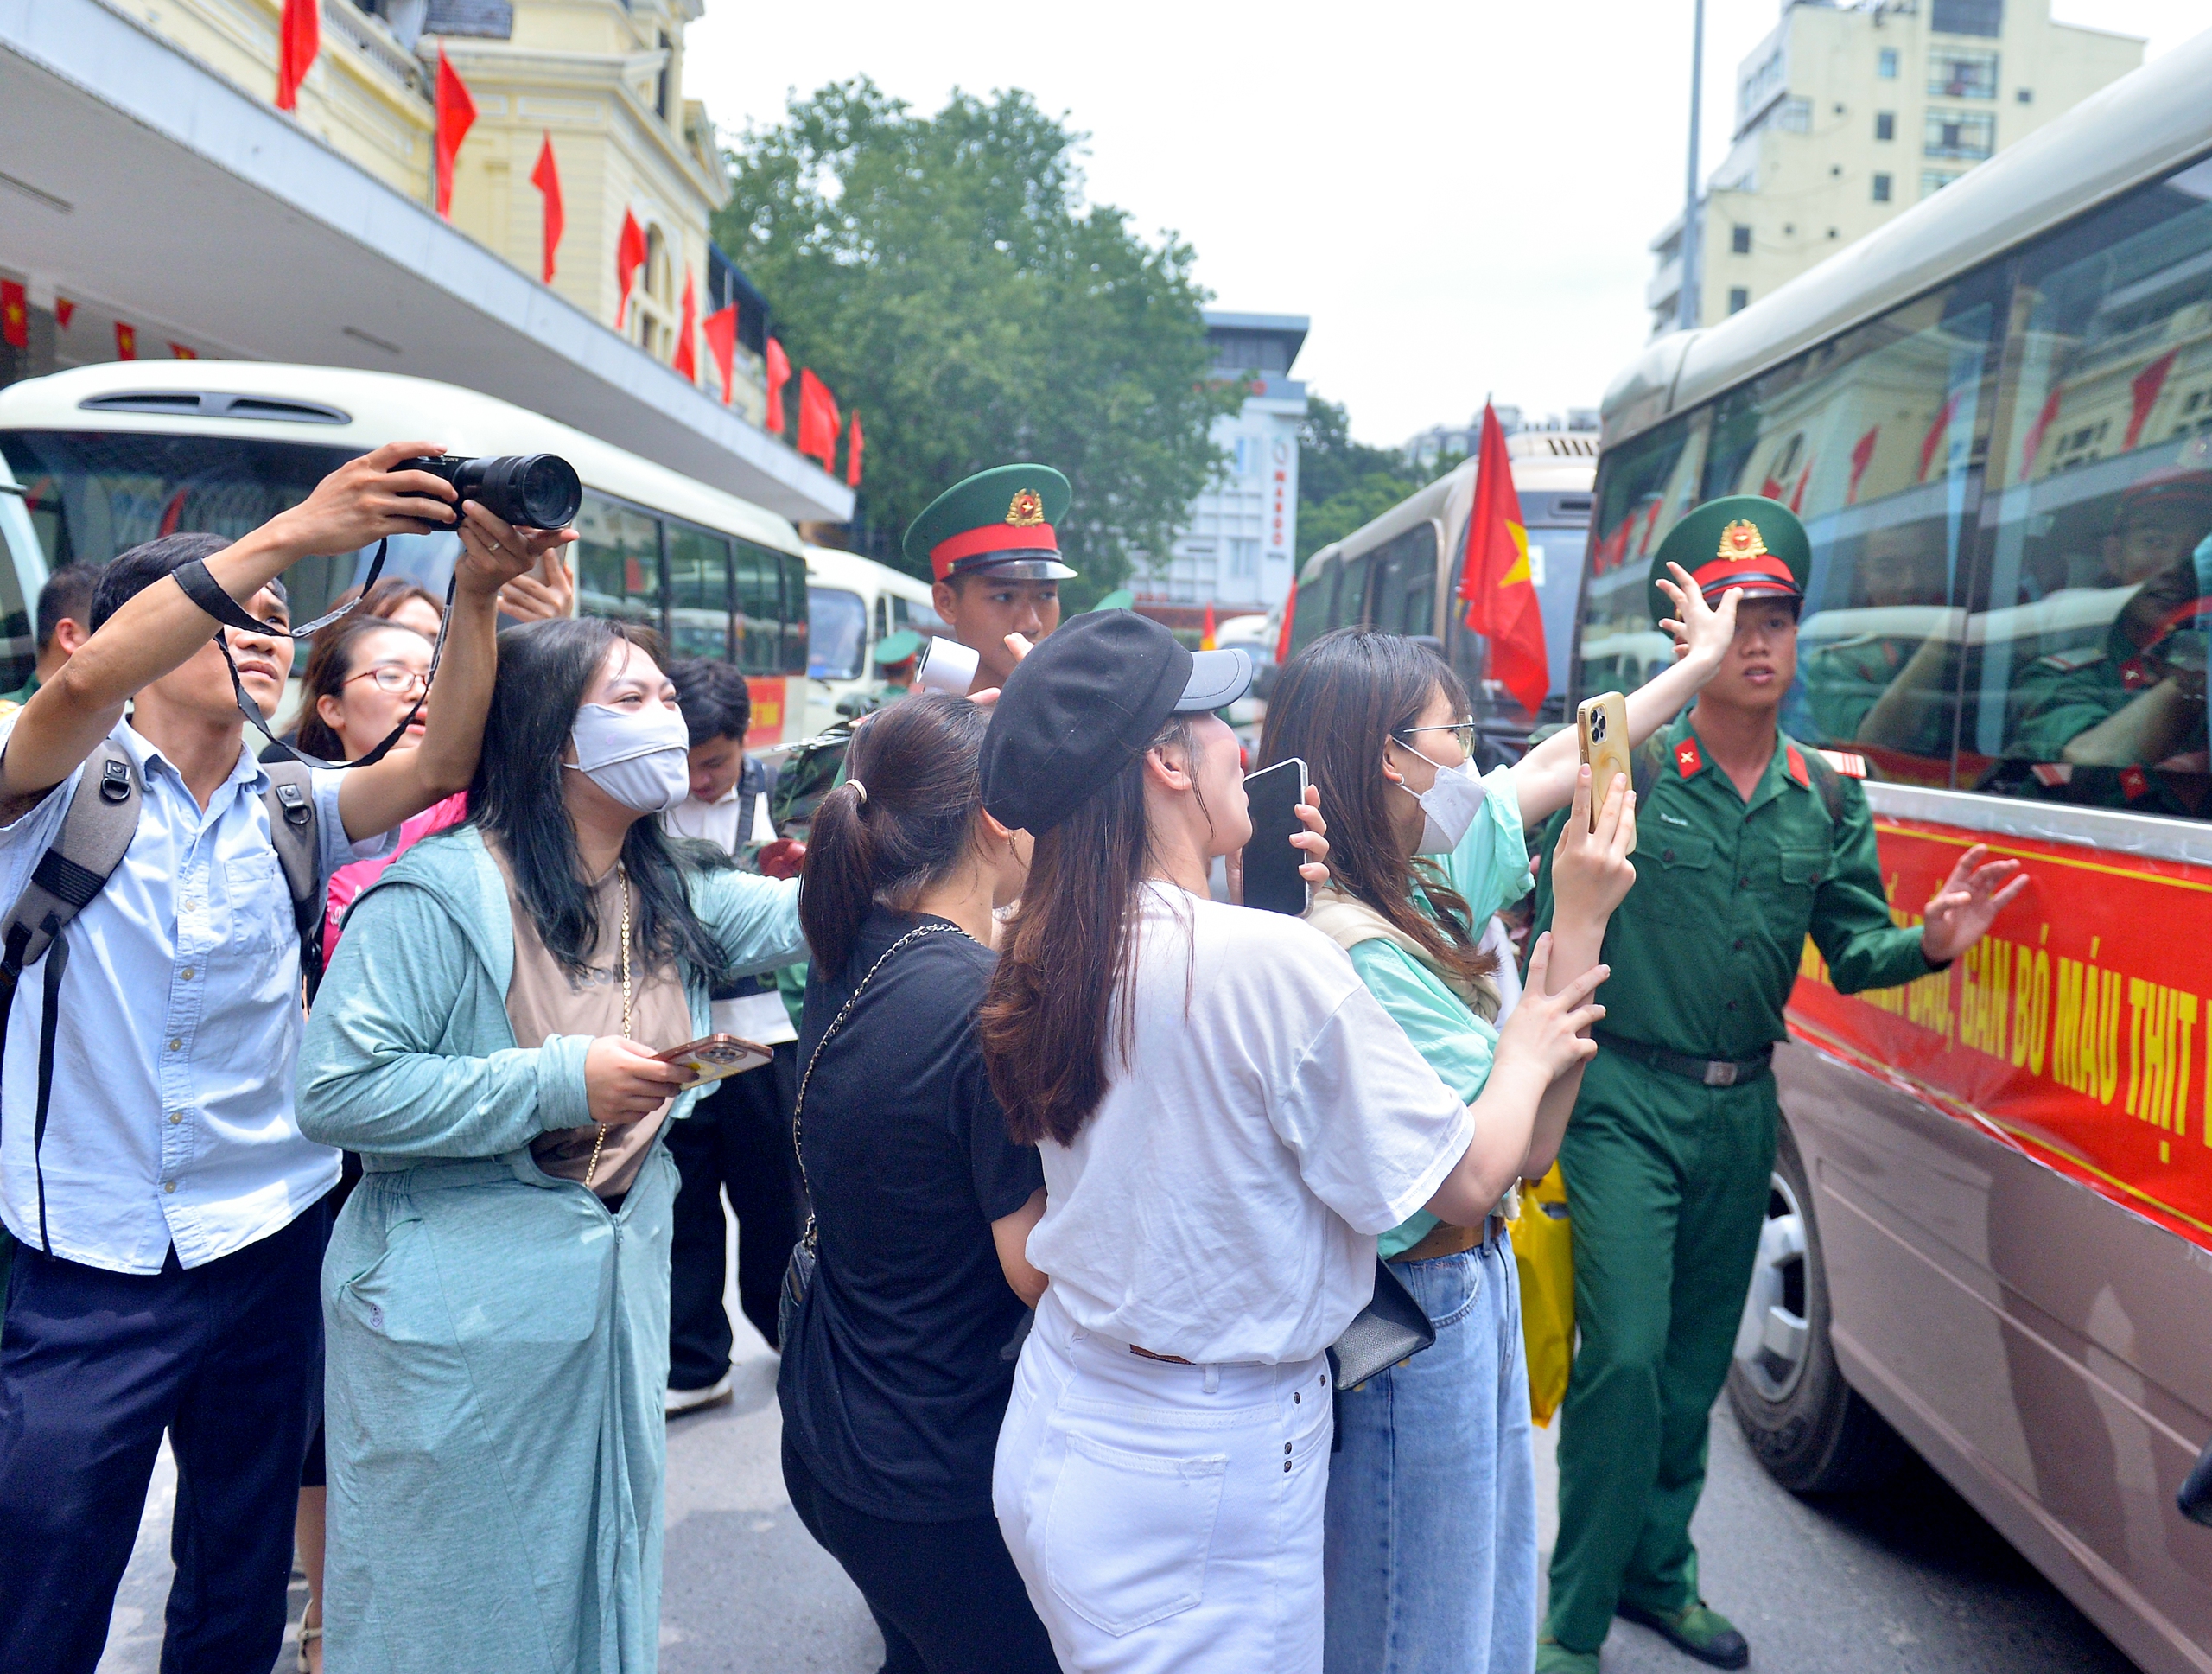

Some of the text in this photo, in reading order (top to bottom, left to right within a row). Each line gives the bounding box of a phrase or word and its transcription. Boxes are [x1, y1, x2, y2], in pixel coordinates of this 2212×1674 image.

[2011, 923, 2050, 1077] BÓ
[2052, 935, 2122, 1106] MÁU
[2125, 976, 2198, 1164] THỊT
